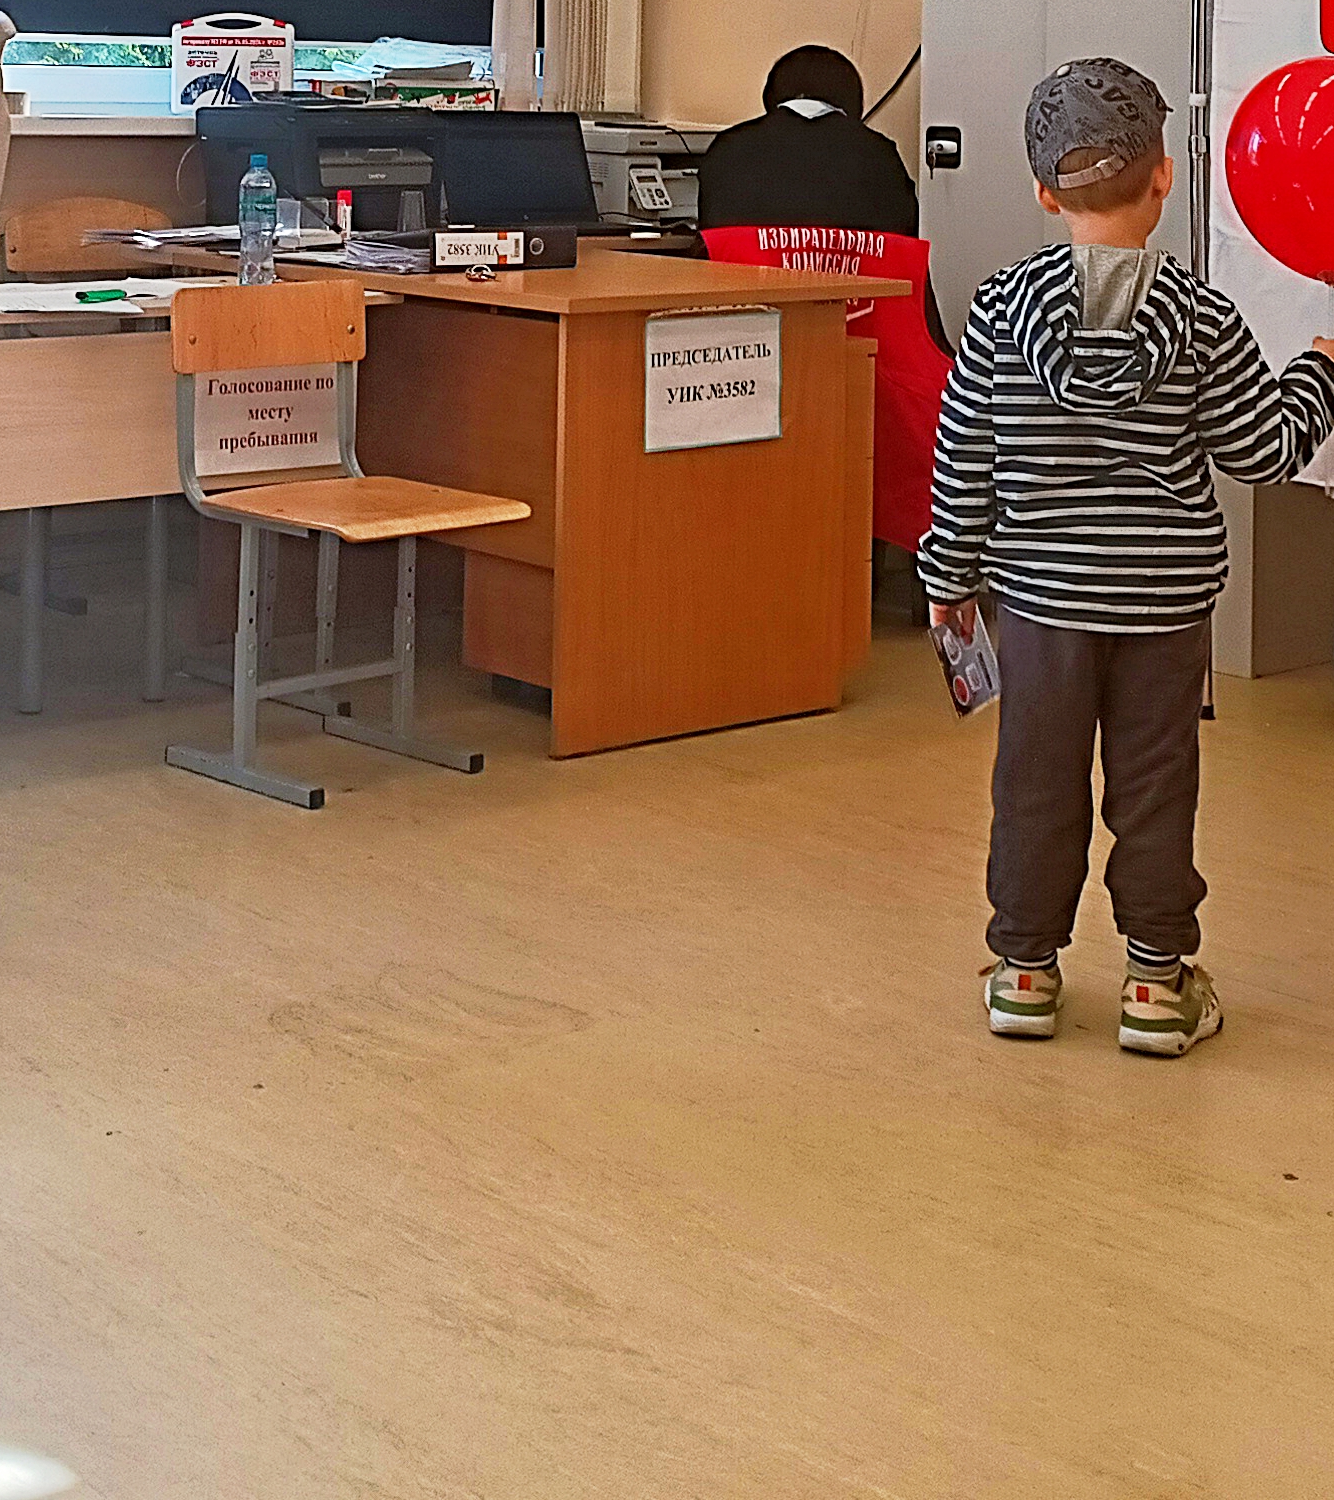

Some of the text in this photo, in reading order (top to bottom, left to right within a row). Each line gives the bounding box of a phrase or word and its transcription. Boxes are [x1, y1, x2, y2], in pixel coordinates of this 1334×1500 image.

[447, 244, 472, 256] 3582
[758, 227, 885, 258] ИЗБИРАТЕЛЬНАЯ
[782, 251, 860, 276] КОМИССИЯ
[650, 343, 771, 368] ПРЕДСЕДАТЕЛЬ
[207, 376, 334, 396] Голосование по
[666, 379, 756, 404] УИК №3582
[248, 406, 294, 422] месту
[219, 431, 318, 454] пребывания
